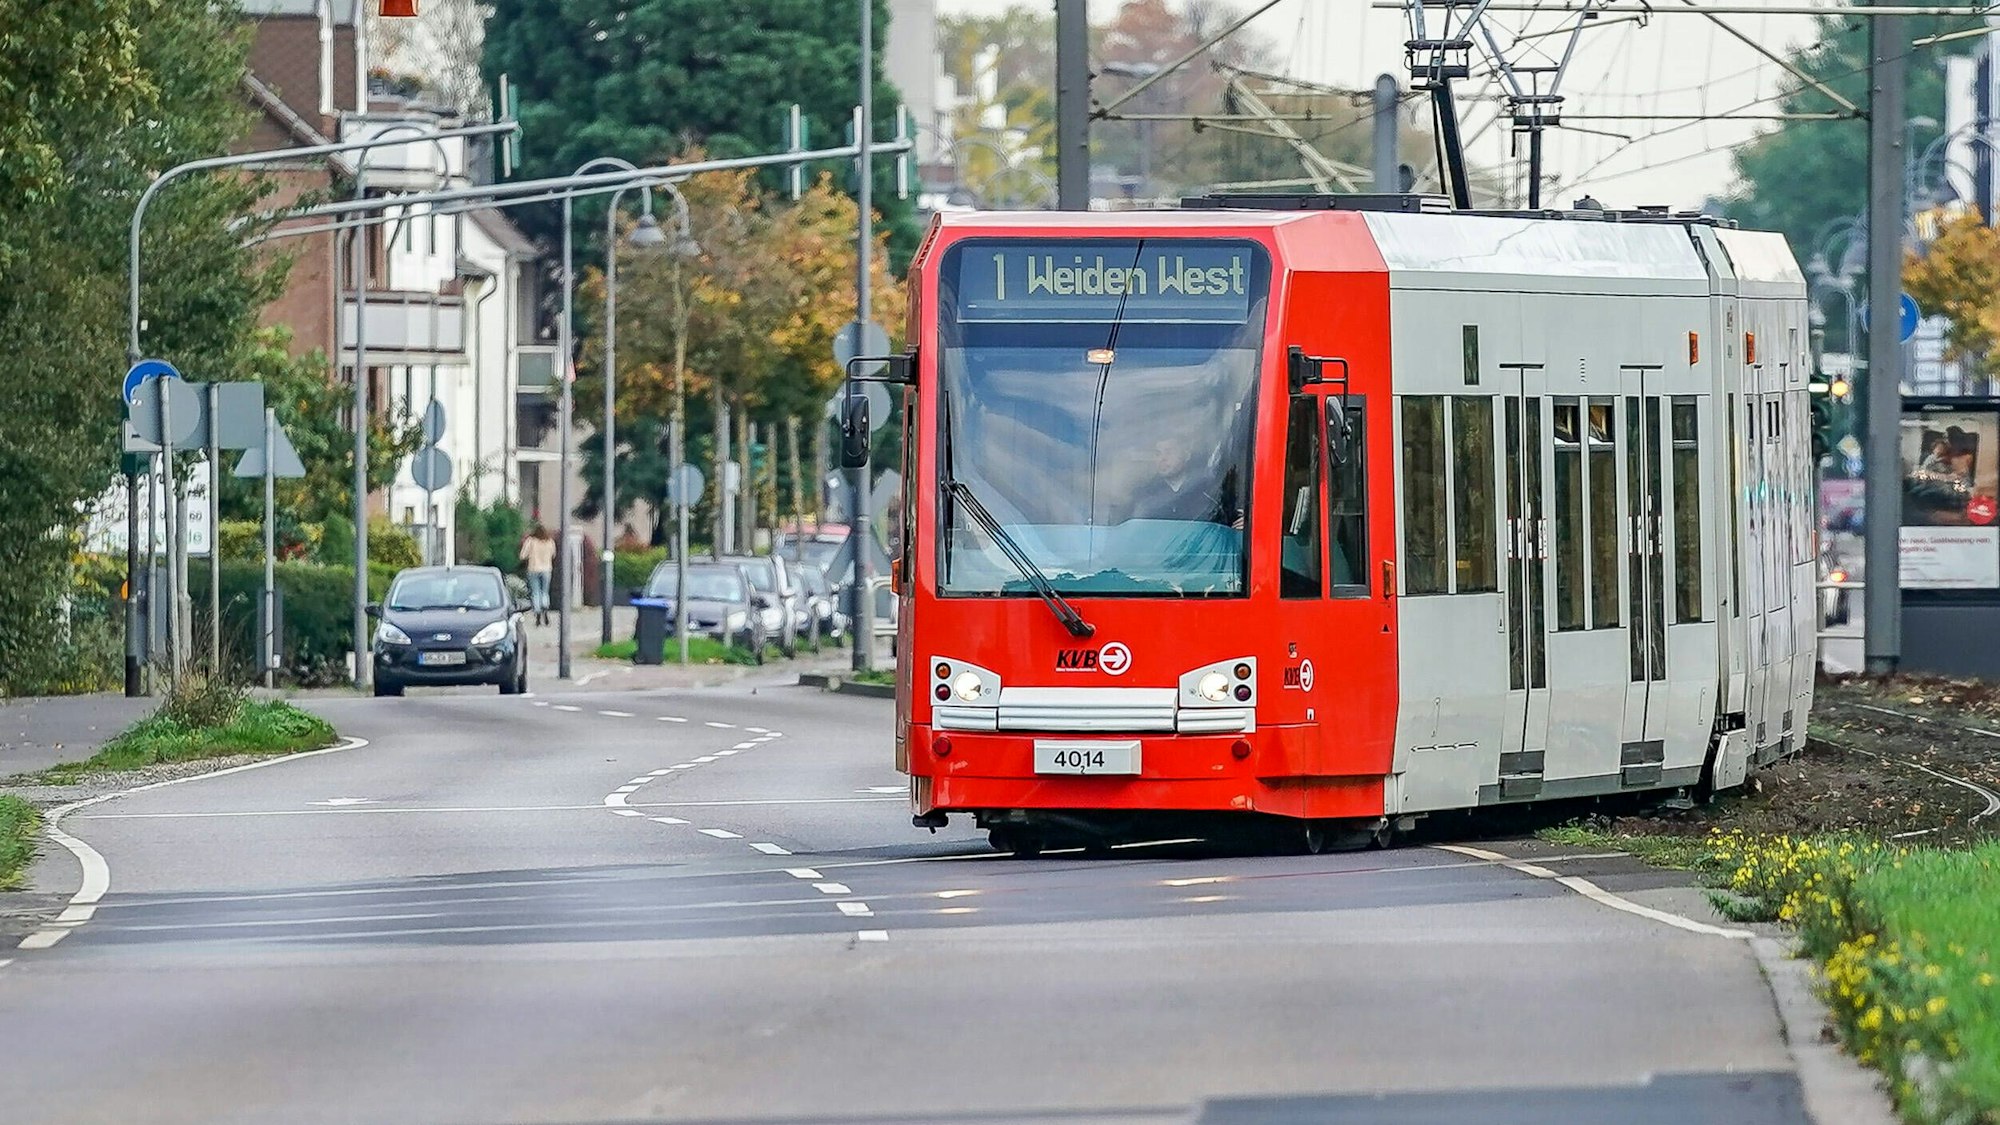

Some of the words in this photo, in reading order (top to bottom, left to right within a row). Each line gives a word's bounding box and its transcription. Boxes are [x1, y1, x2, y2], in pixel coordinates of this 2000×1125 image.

[993, 253, 1005, 301] 1
[1028, 255, 1147, 295] Weiden
[1158, 255, 1245, 295] West
[1056, 649, 1098, 668] KVB
[1054, 750, 1105, 768] 4014
